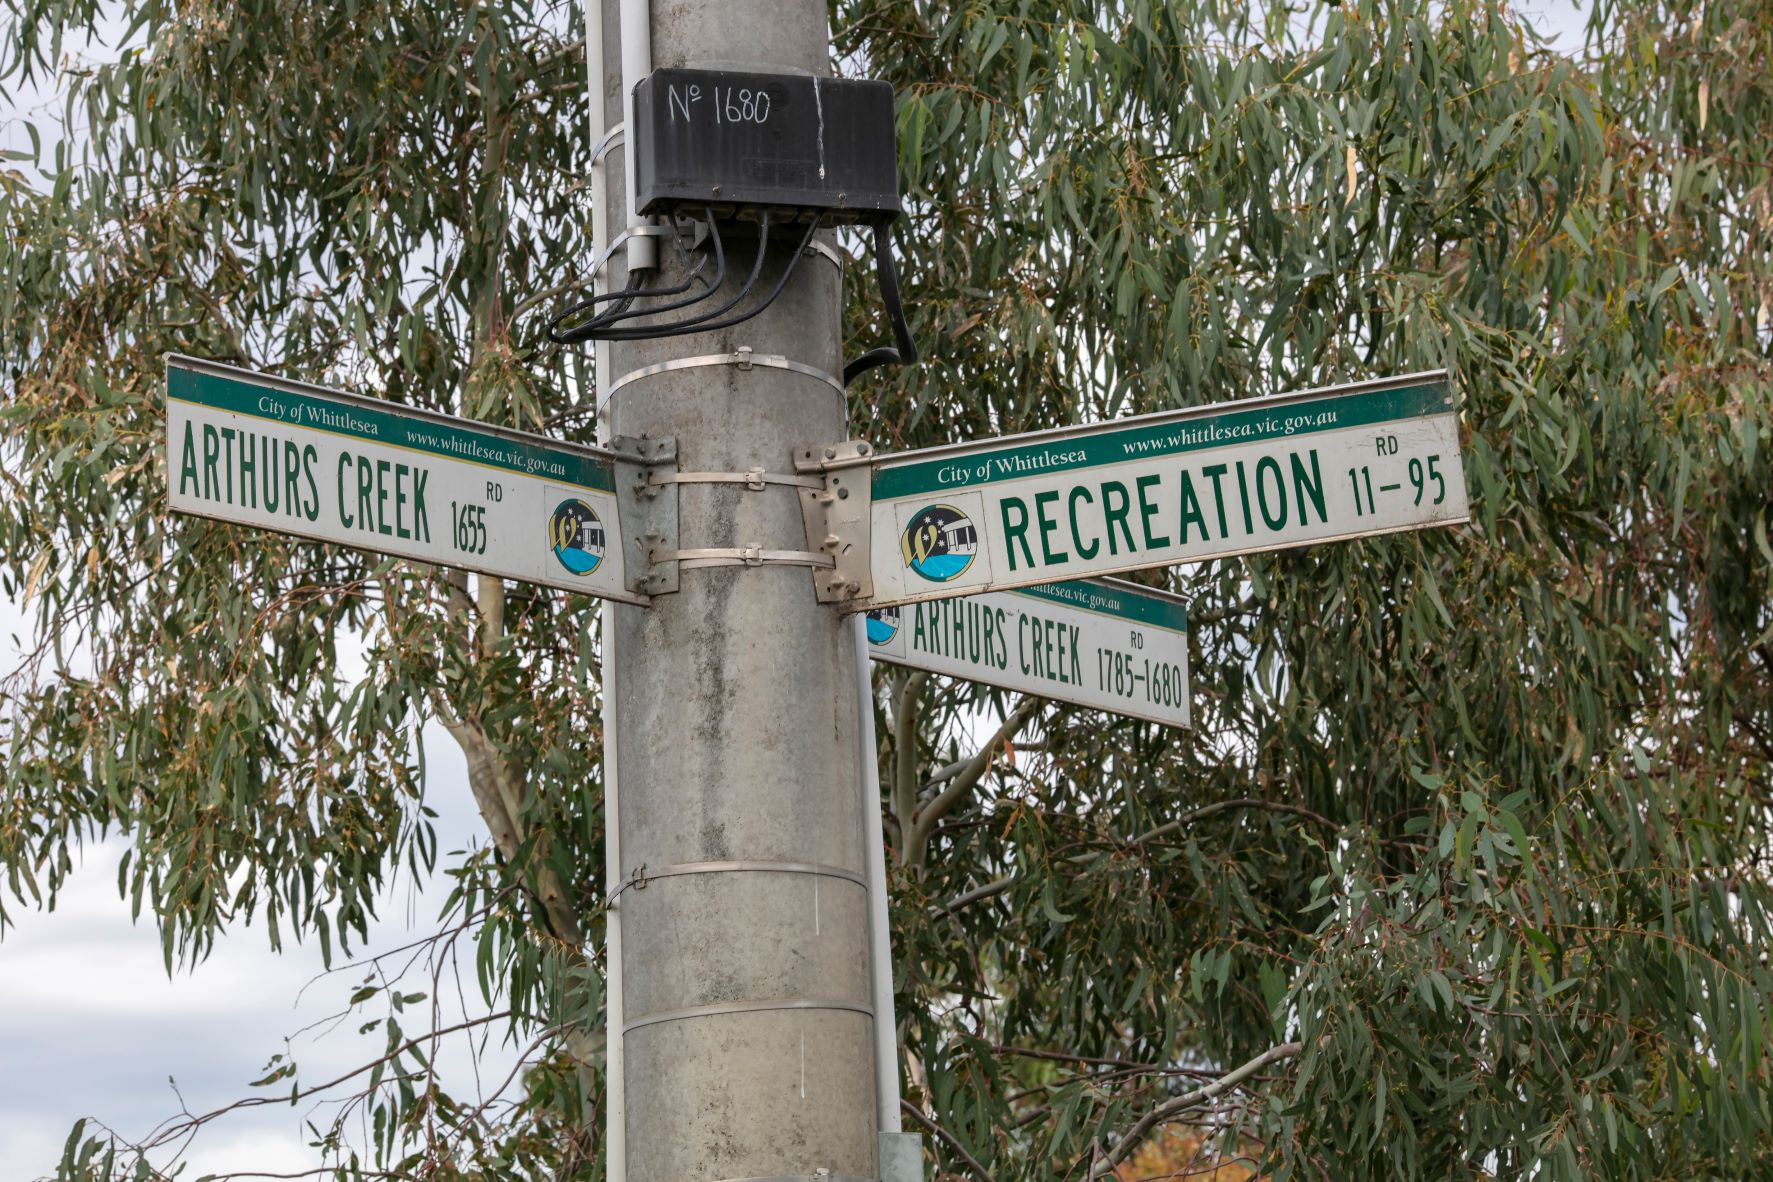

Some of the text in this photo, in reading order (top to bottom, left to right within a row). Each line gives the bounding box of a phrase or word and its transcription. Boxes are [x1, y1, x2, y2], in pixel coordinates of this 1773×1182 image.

[715, 86, 770, 124] 1680
[258, 396, 566, 476] City of Whittlesea www.whittlesea.vic.gov.au
[937, 409, 1338, 485] City of Whittlesea www.whittlesea.vic.gov.au
[1375, 435, 1399, 457] RD
[179, 419, 431, 544] ARTHURS CREEK
[486, 481, 503, 503] RD
[1000, 449, 1329, 571] RECREATION
[451, 500, 487, 555] 1655
[914, 598, 1083, 687] ARTHURS CREEK
[1130, 630, 1143, 650] RD
[1097, 647, 1182, 709] 1785-1680
